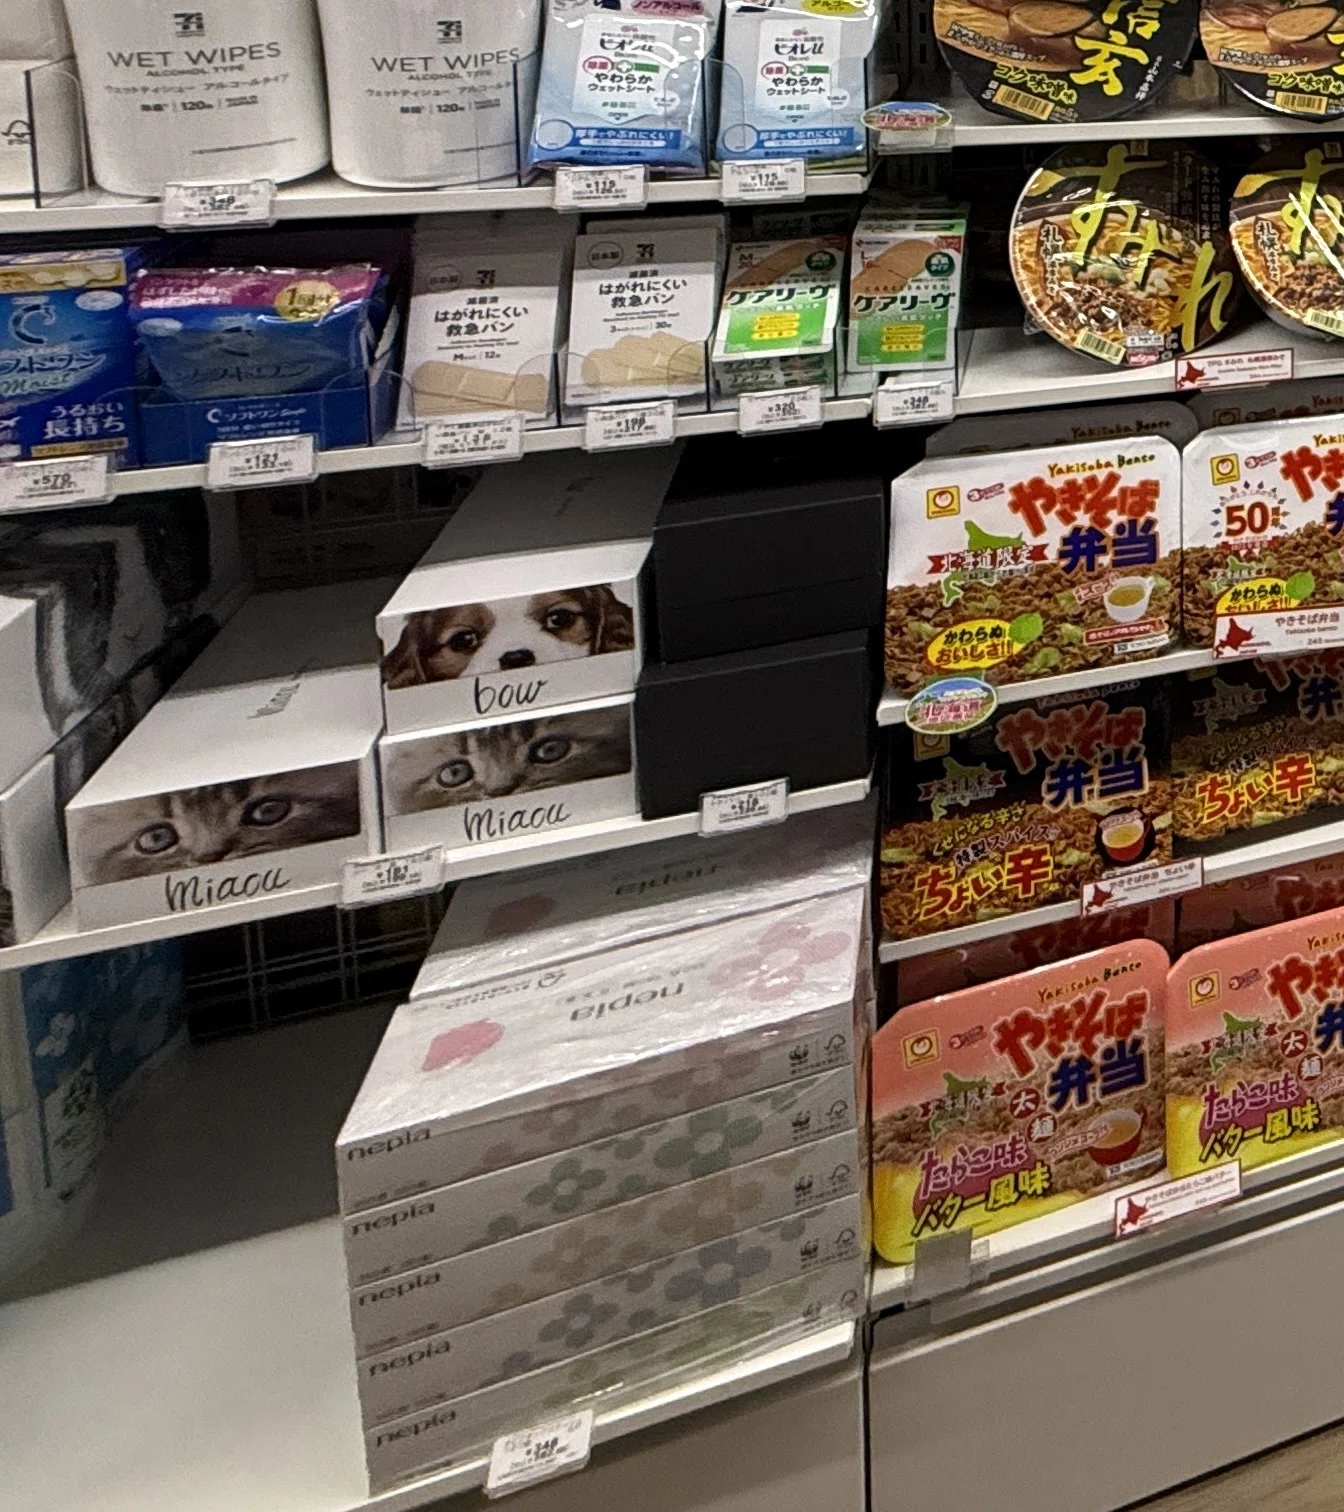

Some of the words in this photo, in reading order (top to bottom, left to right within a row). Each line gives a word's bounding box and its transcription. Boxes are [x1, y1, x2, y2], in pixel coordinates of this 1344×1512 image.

[106, 50, 173, 69] WET
[186, 42, 283, 65] WIPES
[371, 56, 433, 73] WET
[445, 48, 519, 70] WIPES
[595, 72, 653, 85] やわらか
[772, 76, 823, 88] やわらか
[598, 278, 688, 296] はがれにくい
[725, 284, 838, 307] ケアリーヴ
[852, 292, 956, 313] ケアリーヴ
[434, 305, 529, 323] はがれにくい
[43, 414, 126, 439] 長持ち
[1047, 458, 1114, 479] Yakisoba
[1116, 452, 1157, 470] Bento
[1008, 472, 1161, 536] やきそば
[1058, 519, 1158, 574] 弁当
[1229, 581, 1283, 602] かわらぬ
[943, 624, 1005, 647] かわらぬ
[1274, 612, 1340, 627] やきそば弁当
[474, 677, 547, 714] bow
[1195, 754, 1317, 825] ちょい辛
[916, 844, 1054, 920] ちょい辛
[993, 992, 1149, 1079] やきそば
[1047, 1041, 1150, 1110] 弁当
[1203, 1075, 1300, 1124] たらこ味
[1200, 1099, 1321, 1163] バター風味
[919, 1135, 1028, 1201] たらこ味
[914, 1161, 1053, 1235] バター風味
[351, 1201, 436, 1236] nepia
[359, 1272, 441, 1306] nepia
[369, 1339, 451, 1376] nepia
[377, 1410, 457, 1447] nepia
